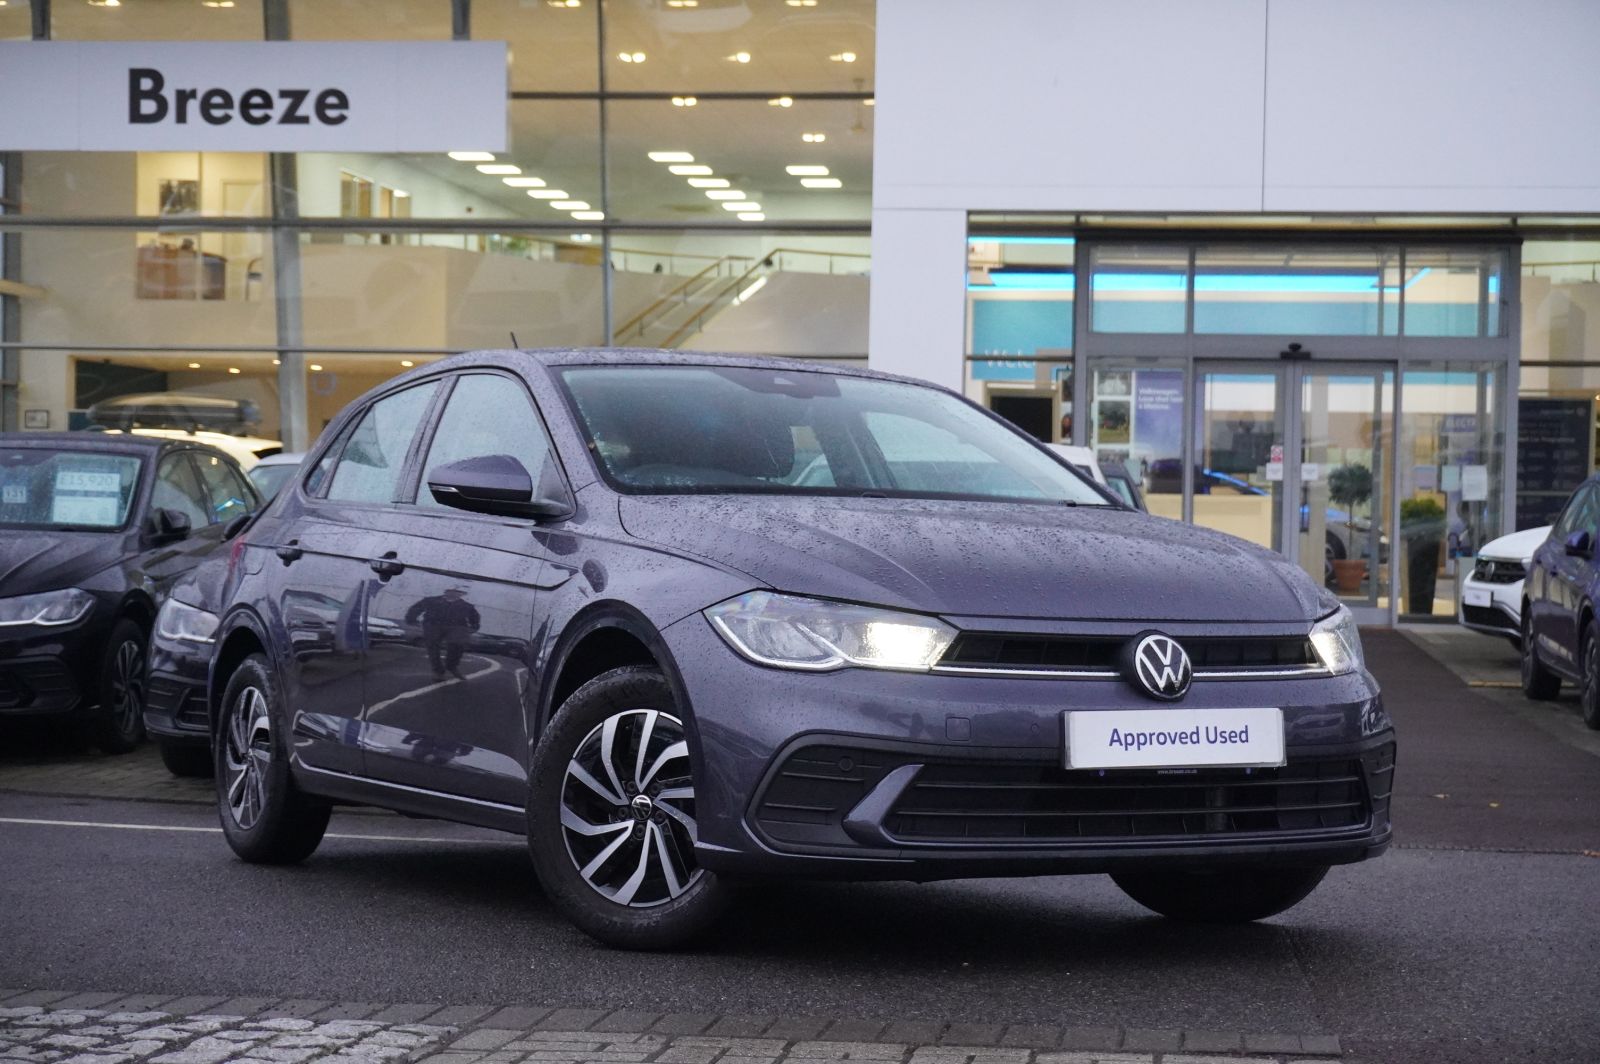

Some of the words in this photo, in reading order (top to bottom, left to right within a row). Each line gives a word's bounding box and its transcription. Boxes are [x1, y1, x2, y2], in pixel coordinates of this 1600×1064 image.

[128, 67, 350, 126] Breeze
[1109, 726, 1200, 751] Approved
[1205, 725, 1249, 745] Used
